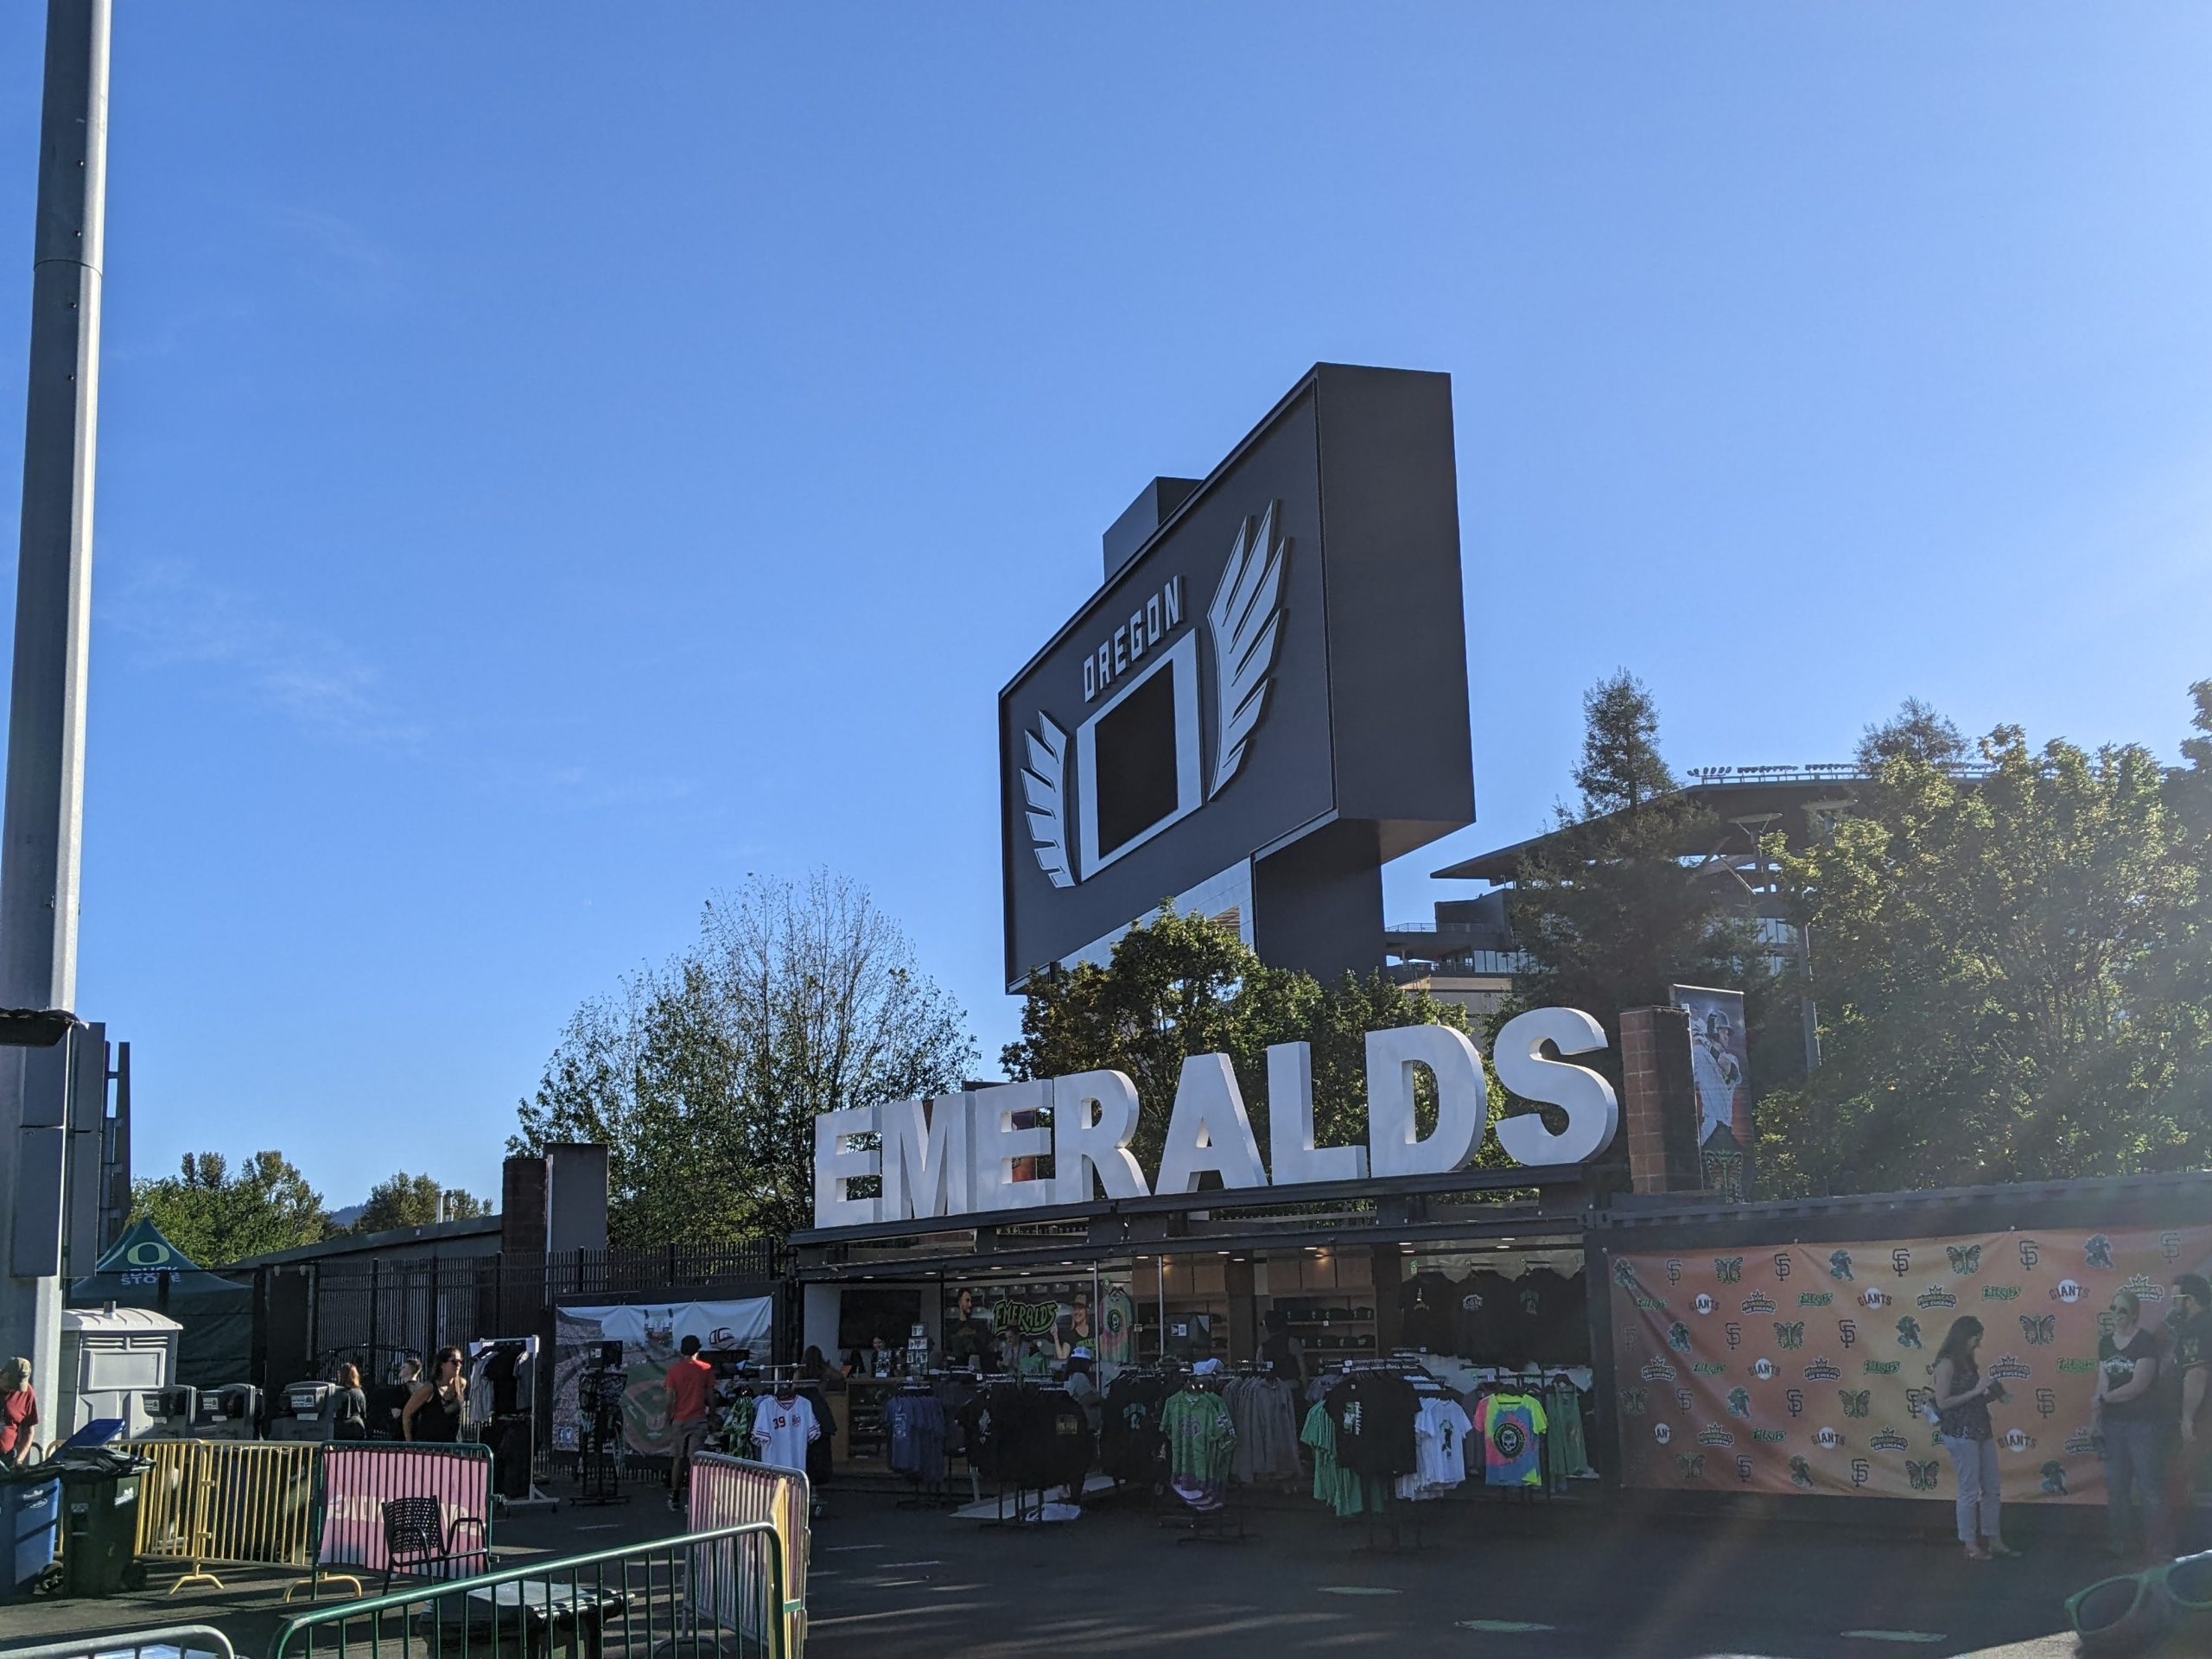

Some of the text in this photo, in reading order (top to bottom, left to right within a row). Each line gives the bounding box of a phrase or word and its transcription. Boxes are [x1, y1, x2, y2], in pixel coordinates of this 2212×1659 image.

[1084, 575, 1180, 703] OREGON
[813, 1007, 1619, 1230] EMERALDS
[120, 1274, 181, 1285] STOE
[2048, 1285, 2090, 1300] GIANTS
[1858, 1294, 1892, 1306] GIANTS
[995, 1301, 1058, 1335] EMERALDS
[1747, 1365, 1781, 1377] GIANTS
[773, 1416, 786, 1430] 39
[1811, 1433, 1846, 1446] GIANTS
[1997, 1434, 2038, 1449] GIANTS
